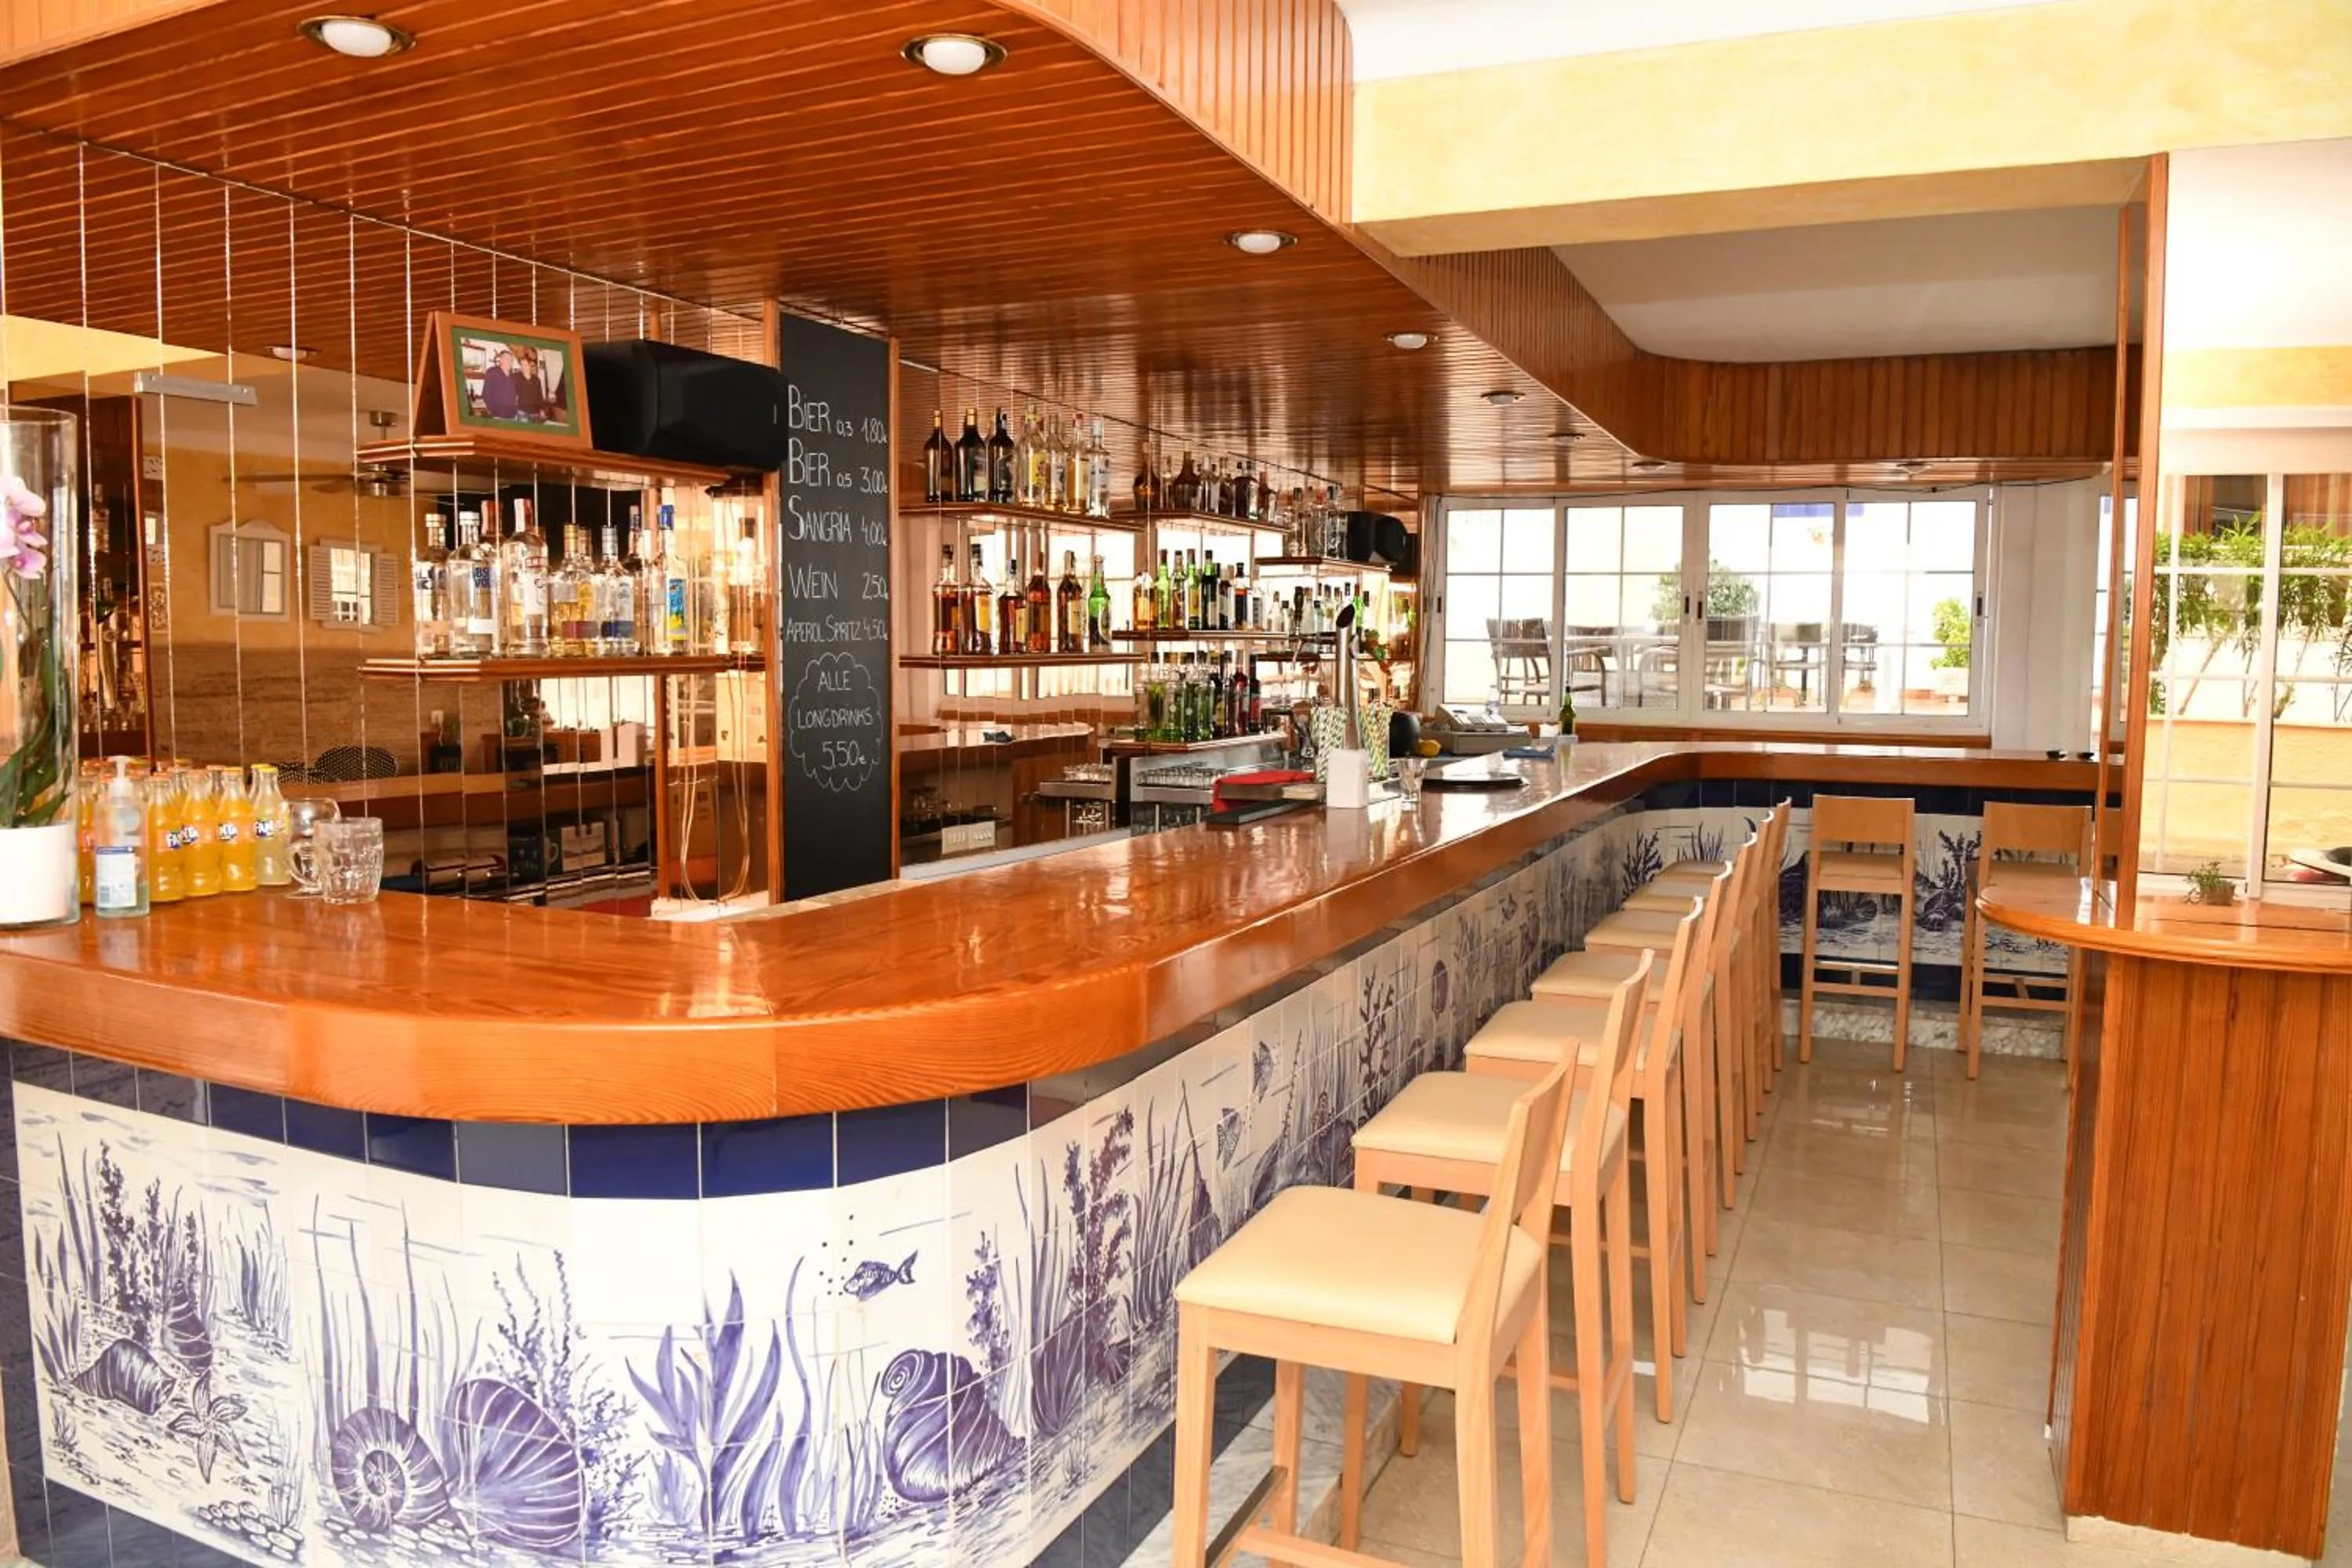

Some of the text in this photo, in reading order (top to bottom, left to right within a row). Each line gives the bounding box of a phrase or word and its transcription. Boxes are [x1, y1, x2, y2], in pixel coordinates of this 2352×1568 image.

[788, 384, 831, 434] BIER
[788, 437, 831, 487] BIER
[837, 473, 853, 488] 0,5
[788, 495, 852, 543] SANGRIA
[788, 562, 838, 600] WEIN
[786, 618, 826, 643] APEROL
[826, 614, 862, 642] SPRITZ
[818, 670, 852, 693] ALLE
[797, 706, 873, 729] LONGDRINKS
